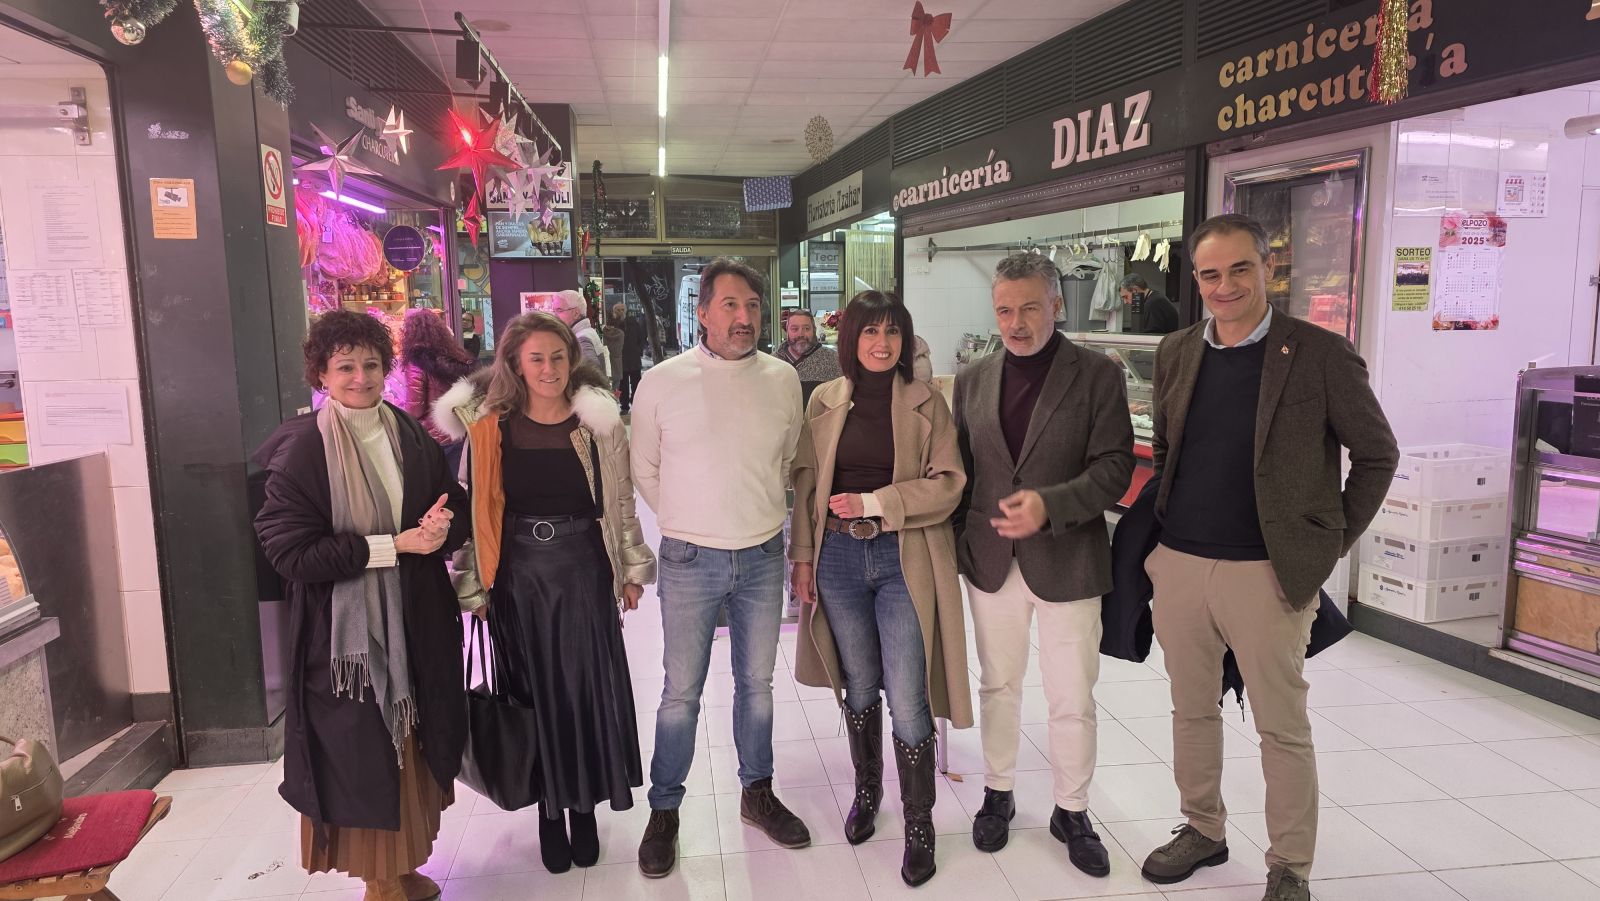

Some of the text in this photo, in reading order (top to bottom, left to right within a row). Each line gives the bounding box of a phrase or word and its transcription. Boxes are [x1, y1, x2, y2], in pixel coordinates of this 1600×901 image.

[1218, 0, 1434, 89] carnicera
[899, 89, 1153, 209] carnicería DIAZ
[1396, 248, 1431, 257] SORTEO
[1461, 236, 1485, 245] 2025
